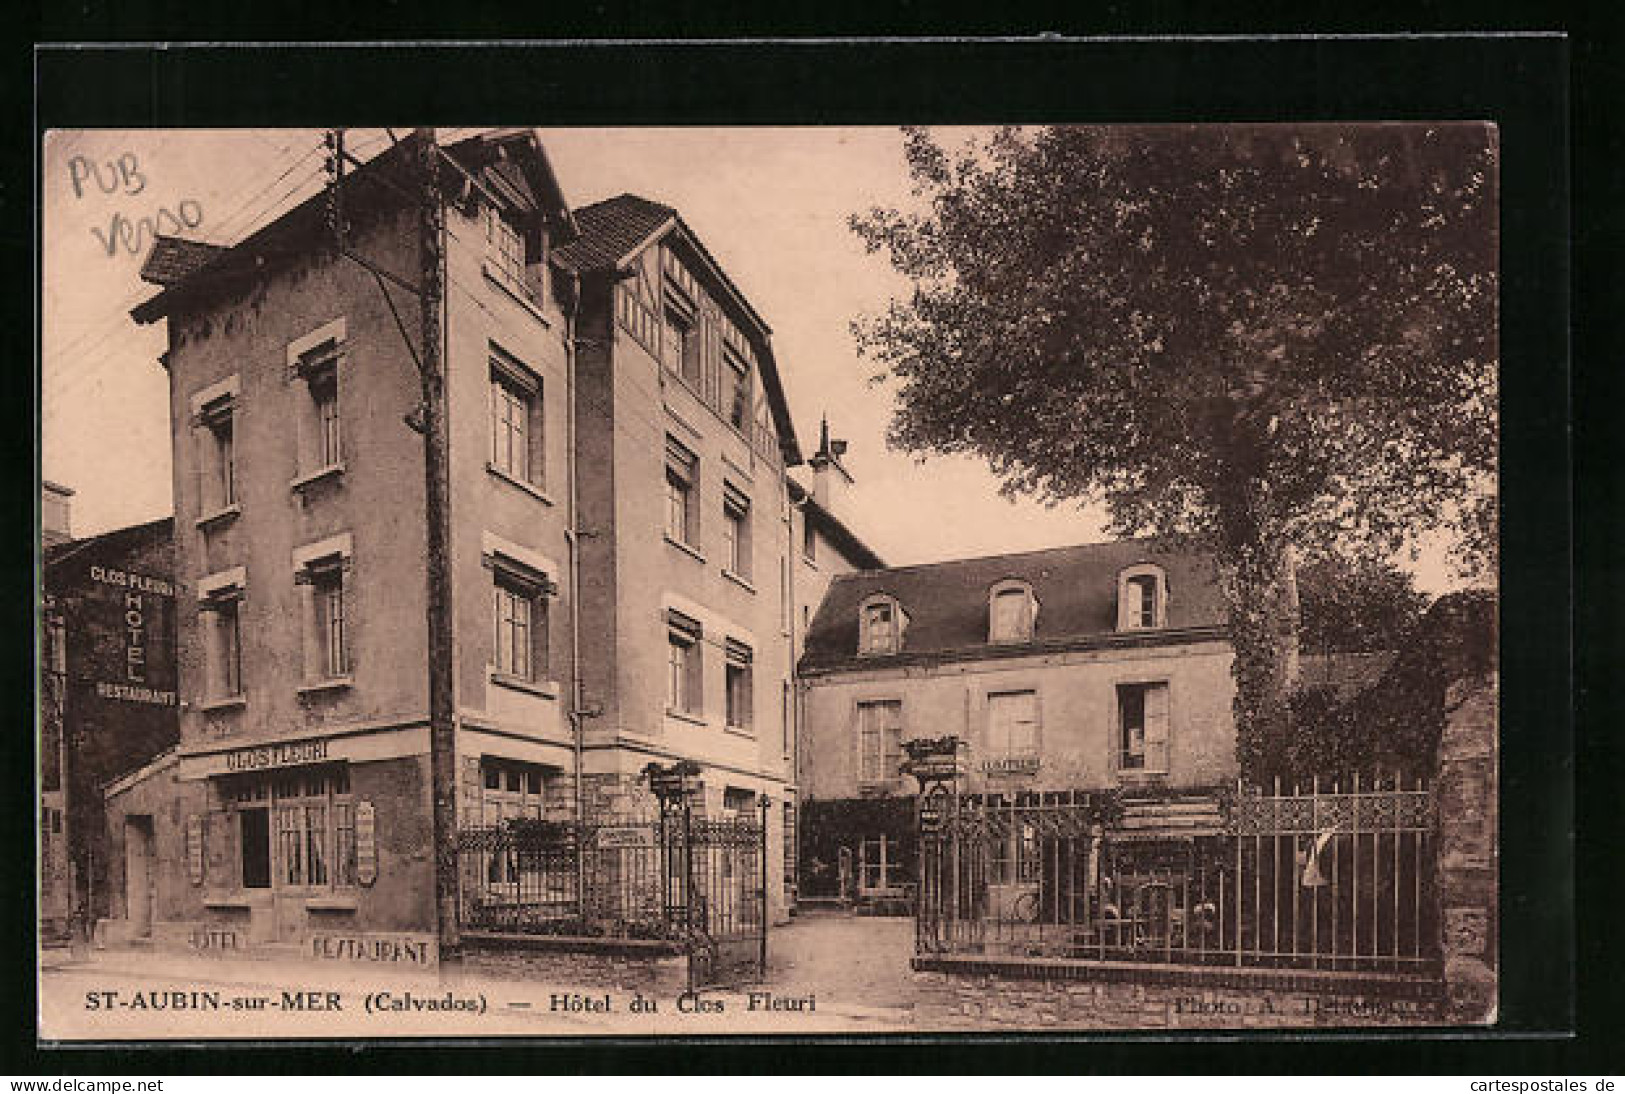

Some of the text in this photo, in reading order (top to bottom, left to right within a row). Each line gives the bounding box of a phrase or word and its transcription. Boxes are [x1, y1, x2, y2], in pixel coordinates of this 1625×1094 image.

[68, 152, 146, 199] PUB
[91, 565, 127, 586] CLOS
[125, 593, 144, 683] HOTEL
[97, 682, 176, 706] RESTAURANT
[85, 991, 342, 1012] ST-AUBIN-sur-MER
[365, 992, 487, 1015] (Calvados)
[549, 993, 613, 1012] Hôtel
[629, 994, 658, 1013] du
[676, 994, 725, 1013] Clos
[747, 994, 816, 1012] Fleuri
